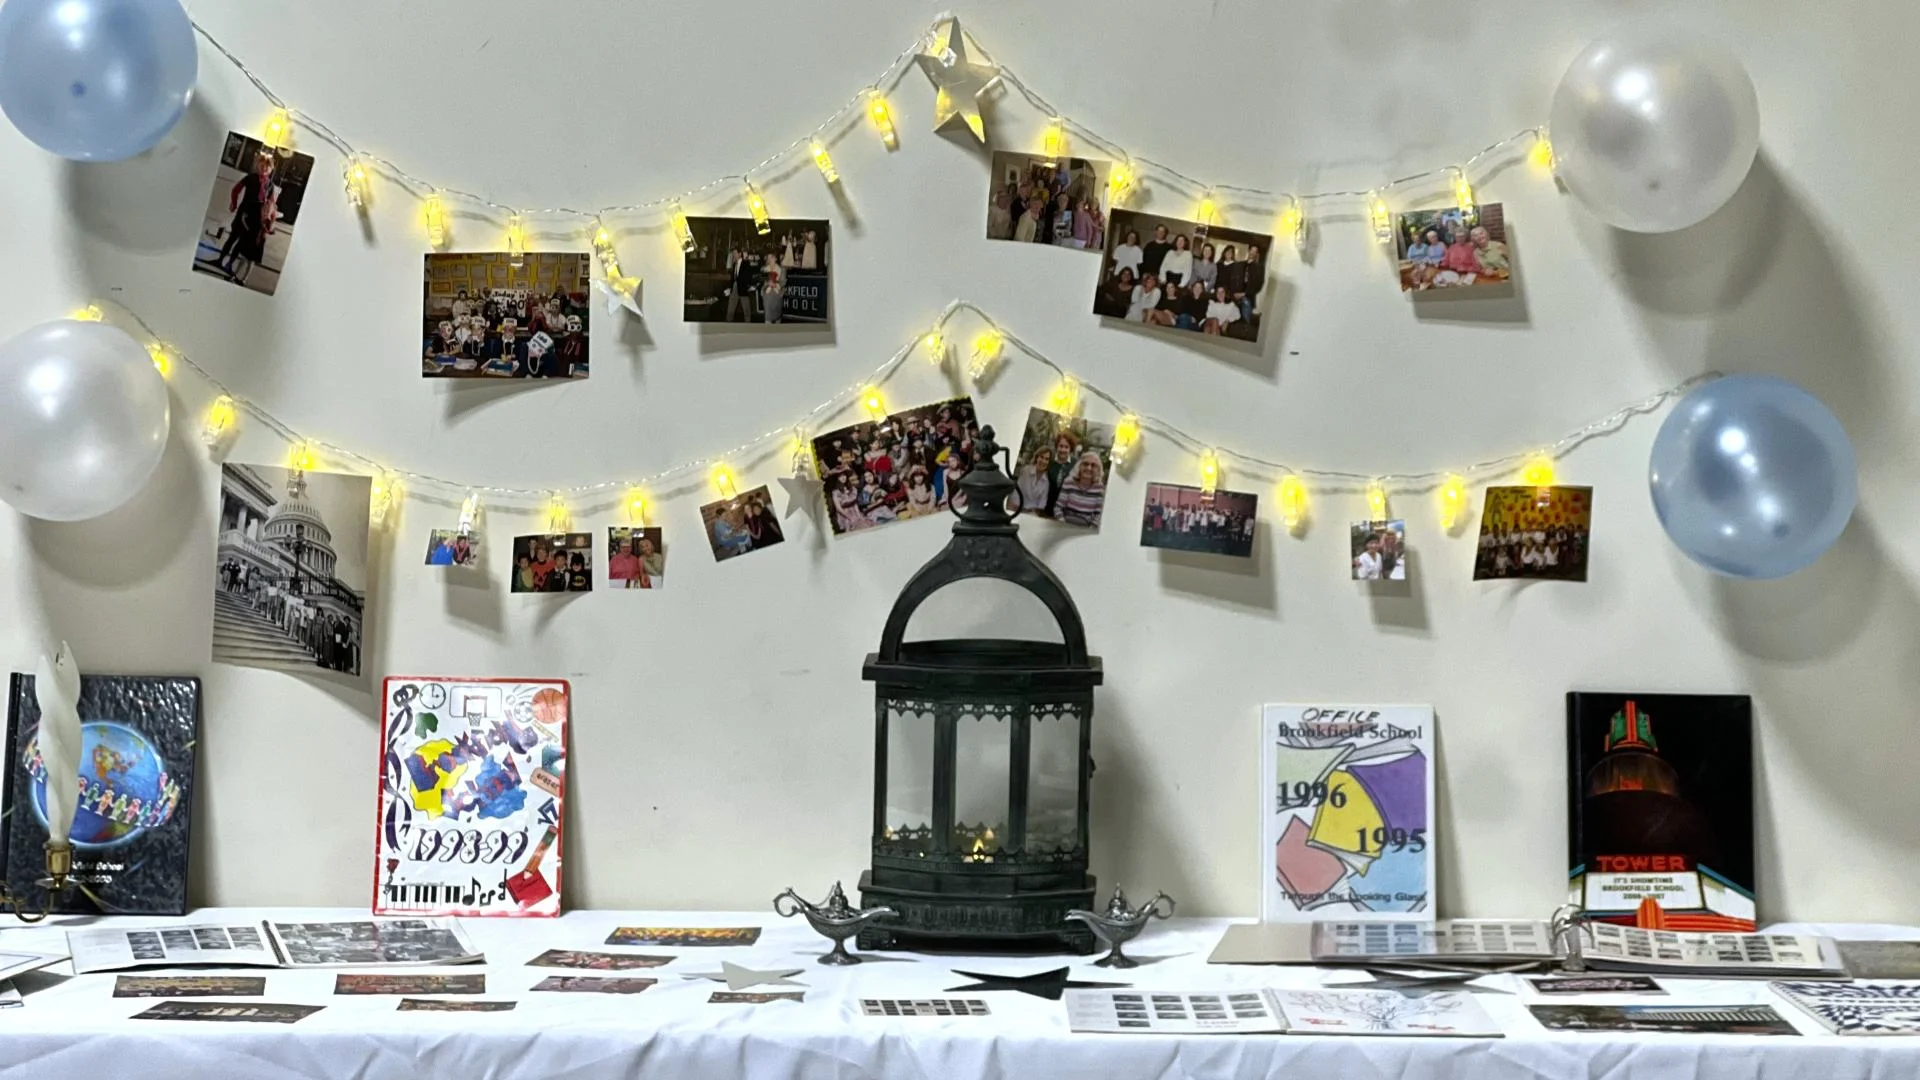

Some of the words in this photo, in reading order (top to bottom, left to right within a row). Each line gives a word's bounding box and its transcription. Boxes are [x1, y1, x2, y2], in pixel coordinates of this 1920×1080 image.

[785, 285, 818, 297] KFIELD
[783, 298, 818, 310] HOOL
[1301, 707, 1381, 723] OFFICE
[1278, 722, 1364, 738] Brookfield
[1369, 724, 1423, 740] School
[1277, 780, 1347, 809] 1996
[407, 827, 529, 865] 1998-99
[1356, 827, 1427, 854] 1995
[1595, 856, 1685, 873] TOWER
